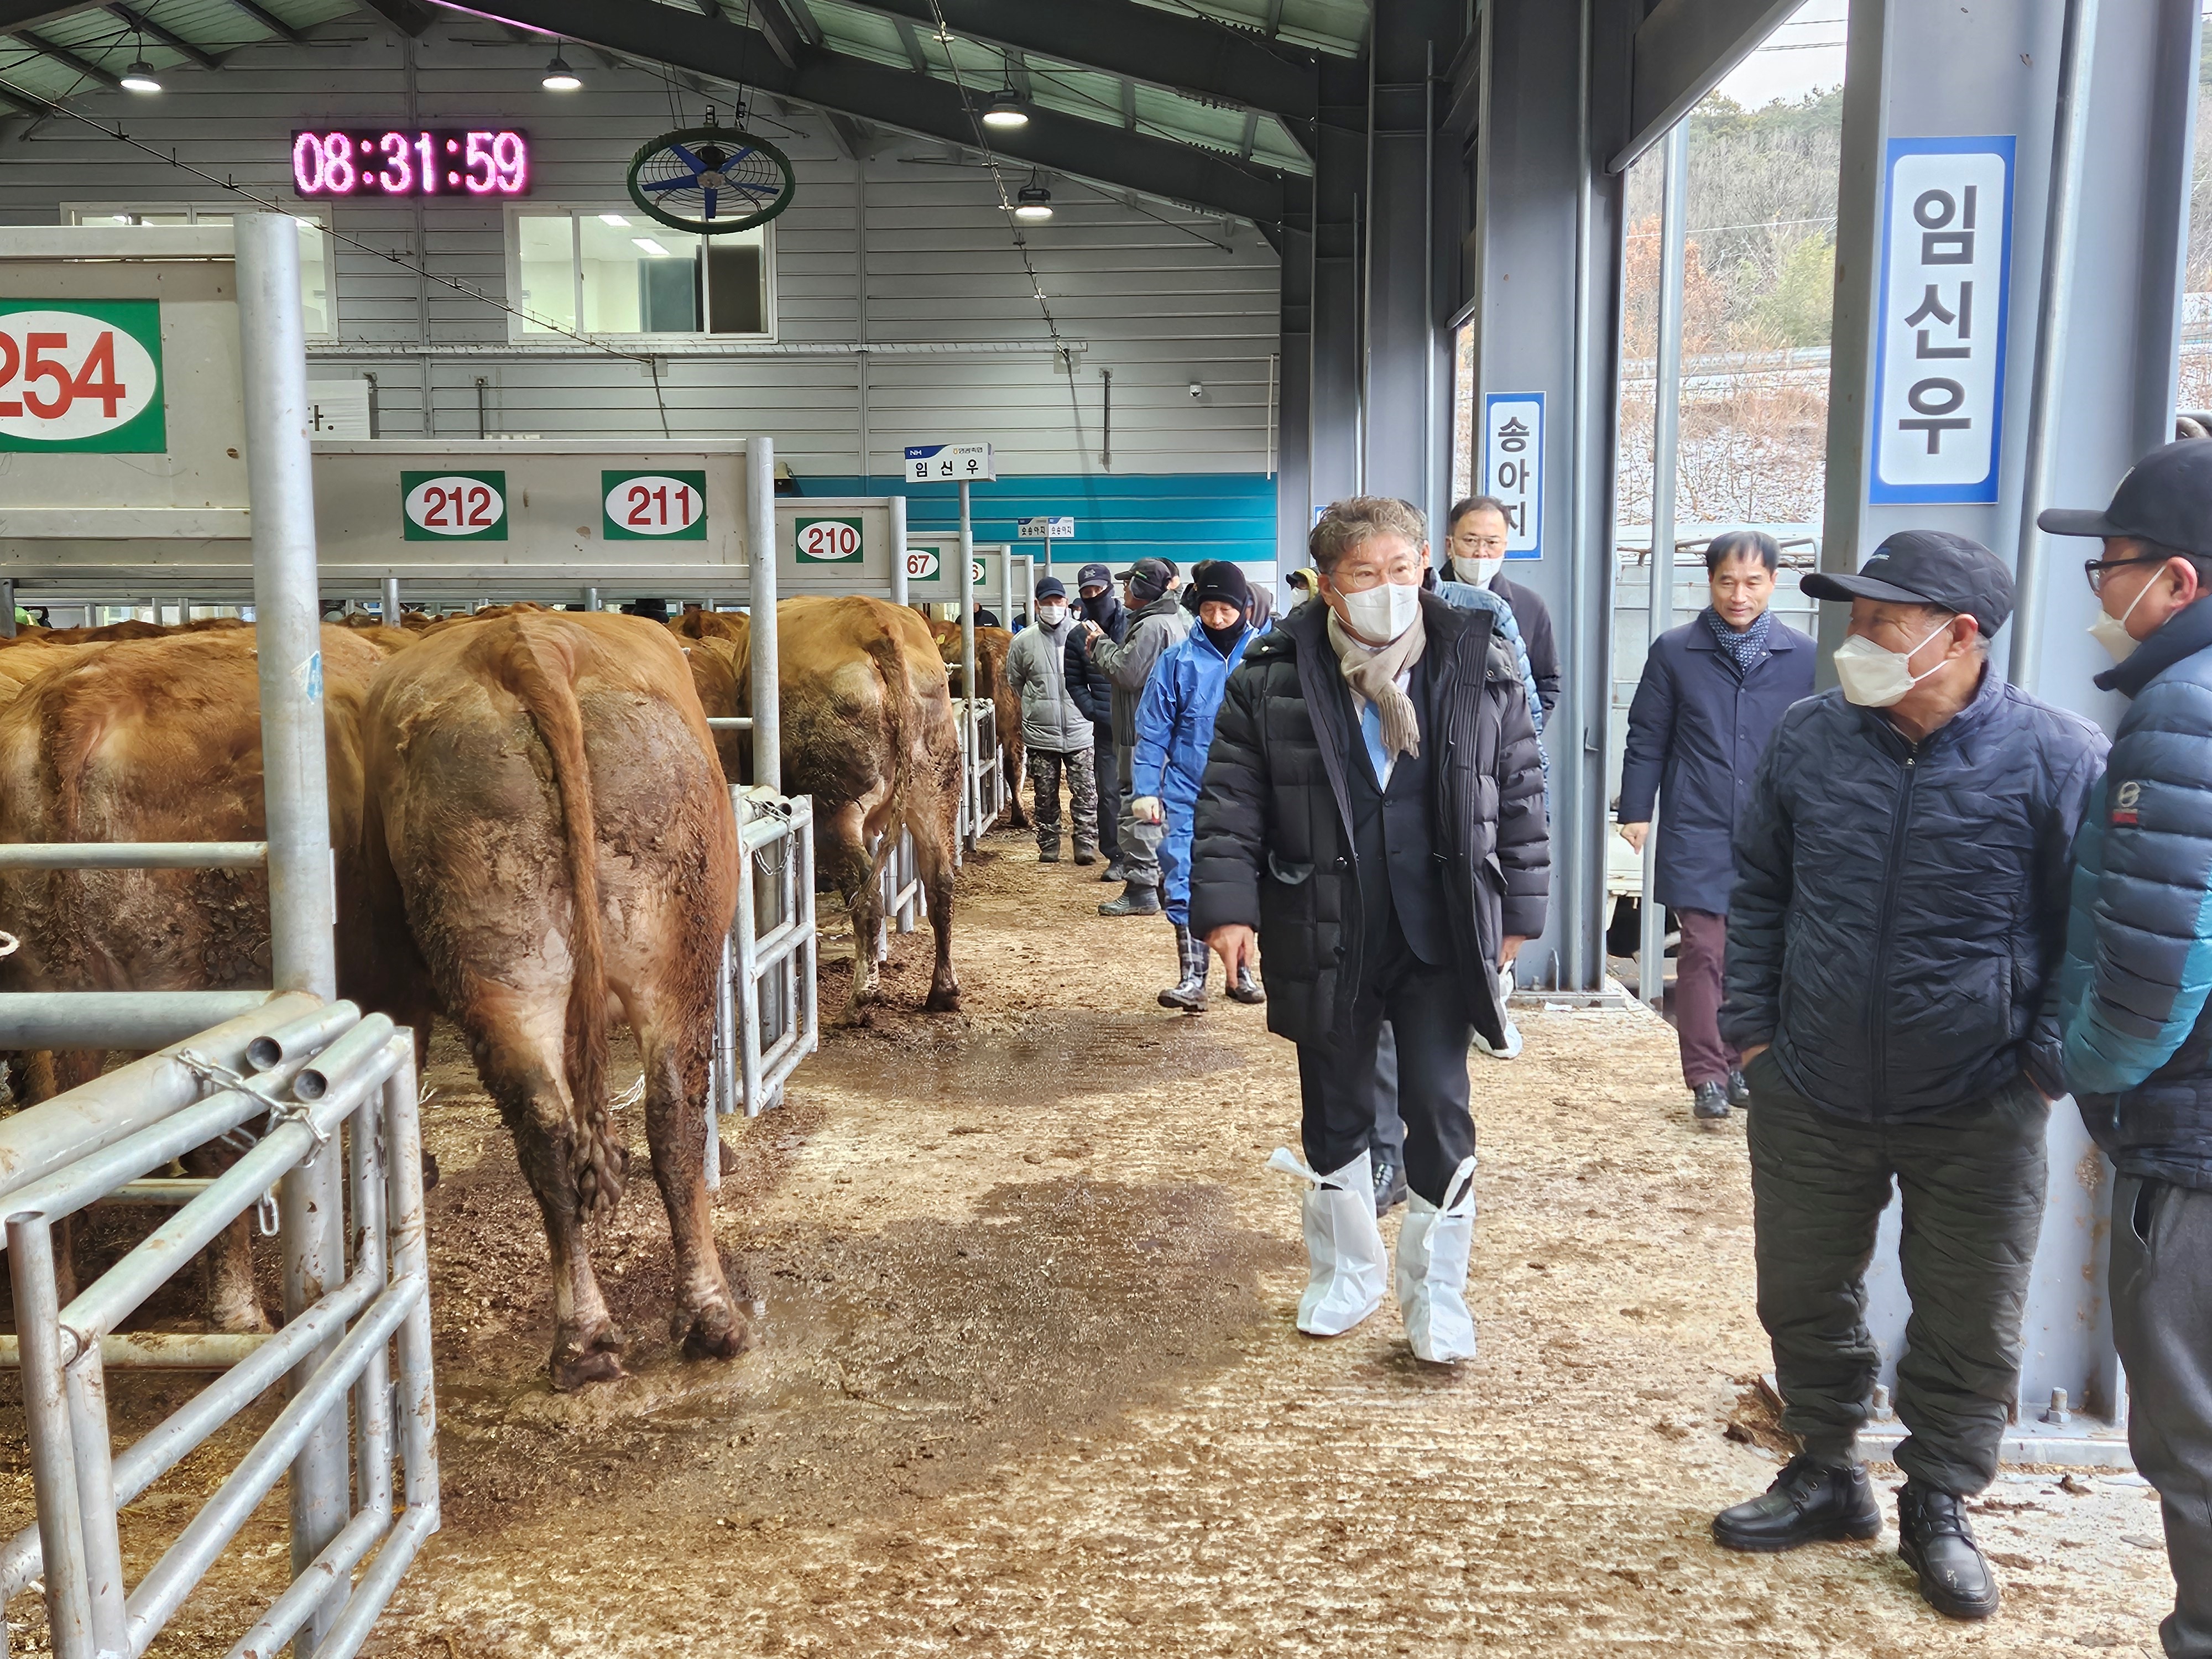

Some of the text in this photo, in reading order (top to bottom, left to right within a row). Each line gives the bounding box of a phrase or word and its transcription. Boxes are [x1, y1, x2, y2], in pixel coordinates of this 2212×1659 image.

[293, 131, 525, 193] 08:31:59
[1898, 185, 1977, 455] 임신우
[915, 459, 979, 478] 임신우
[1498, 416, 1530, 536] 송아지
[424, 487, 492, 526] 212
[628, 486, 690, 525] 211
[808, 528, 855, 554] 210
